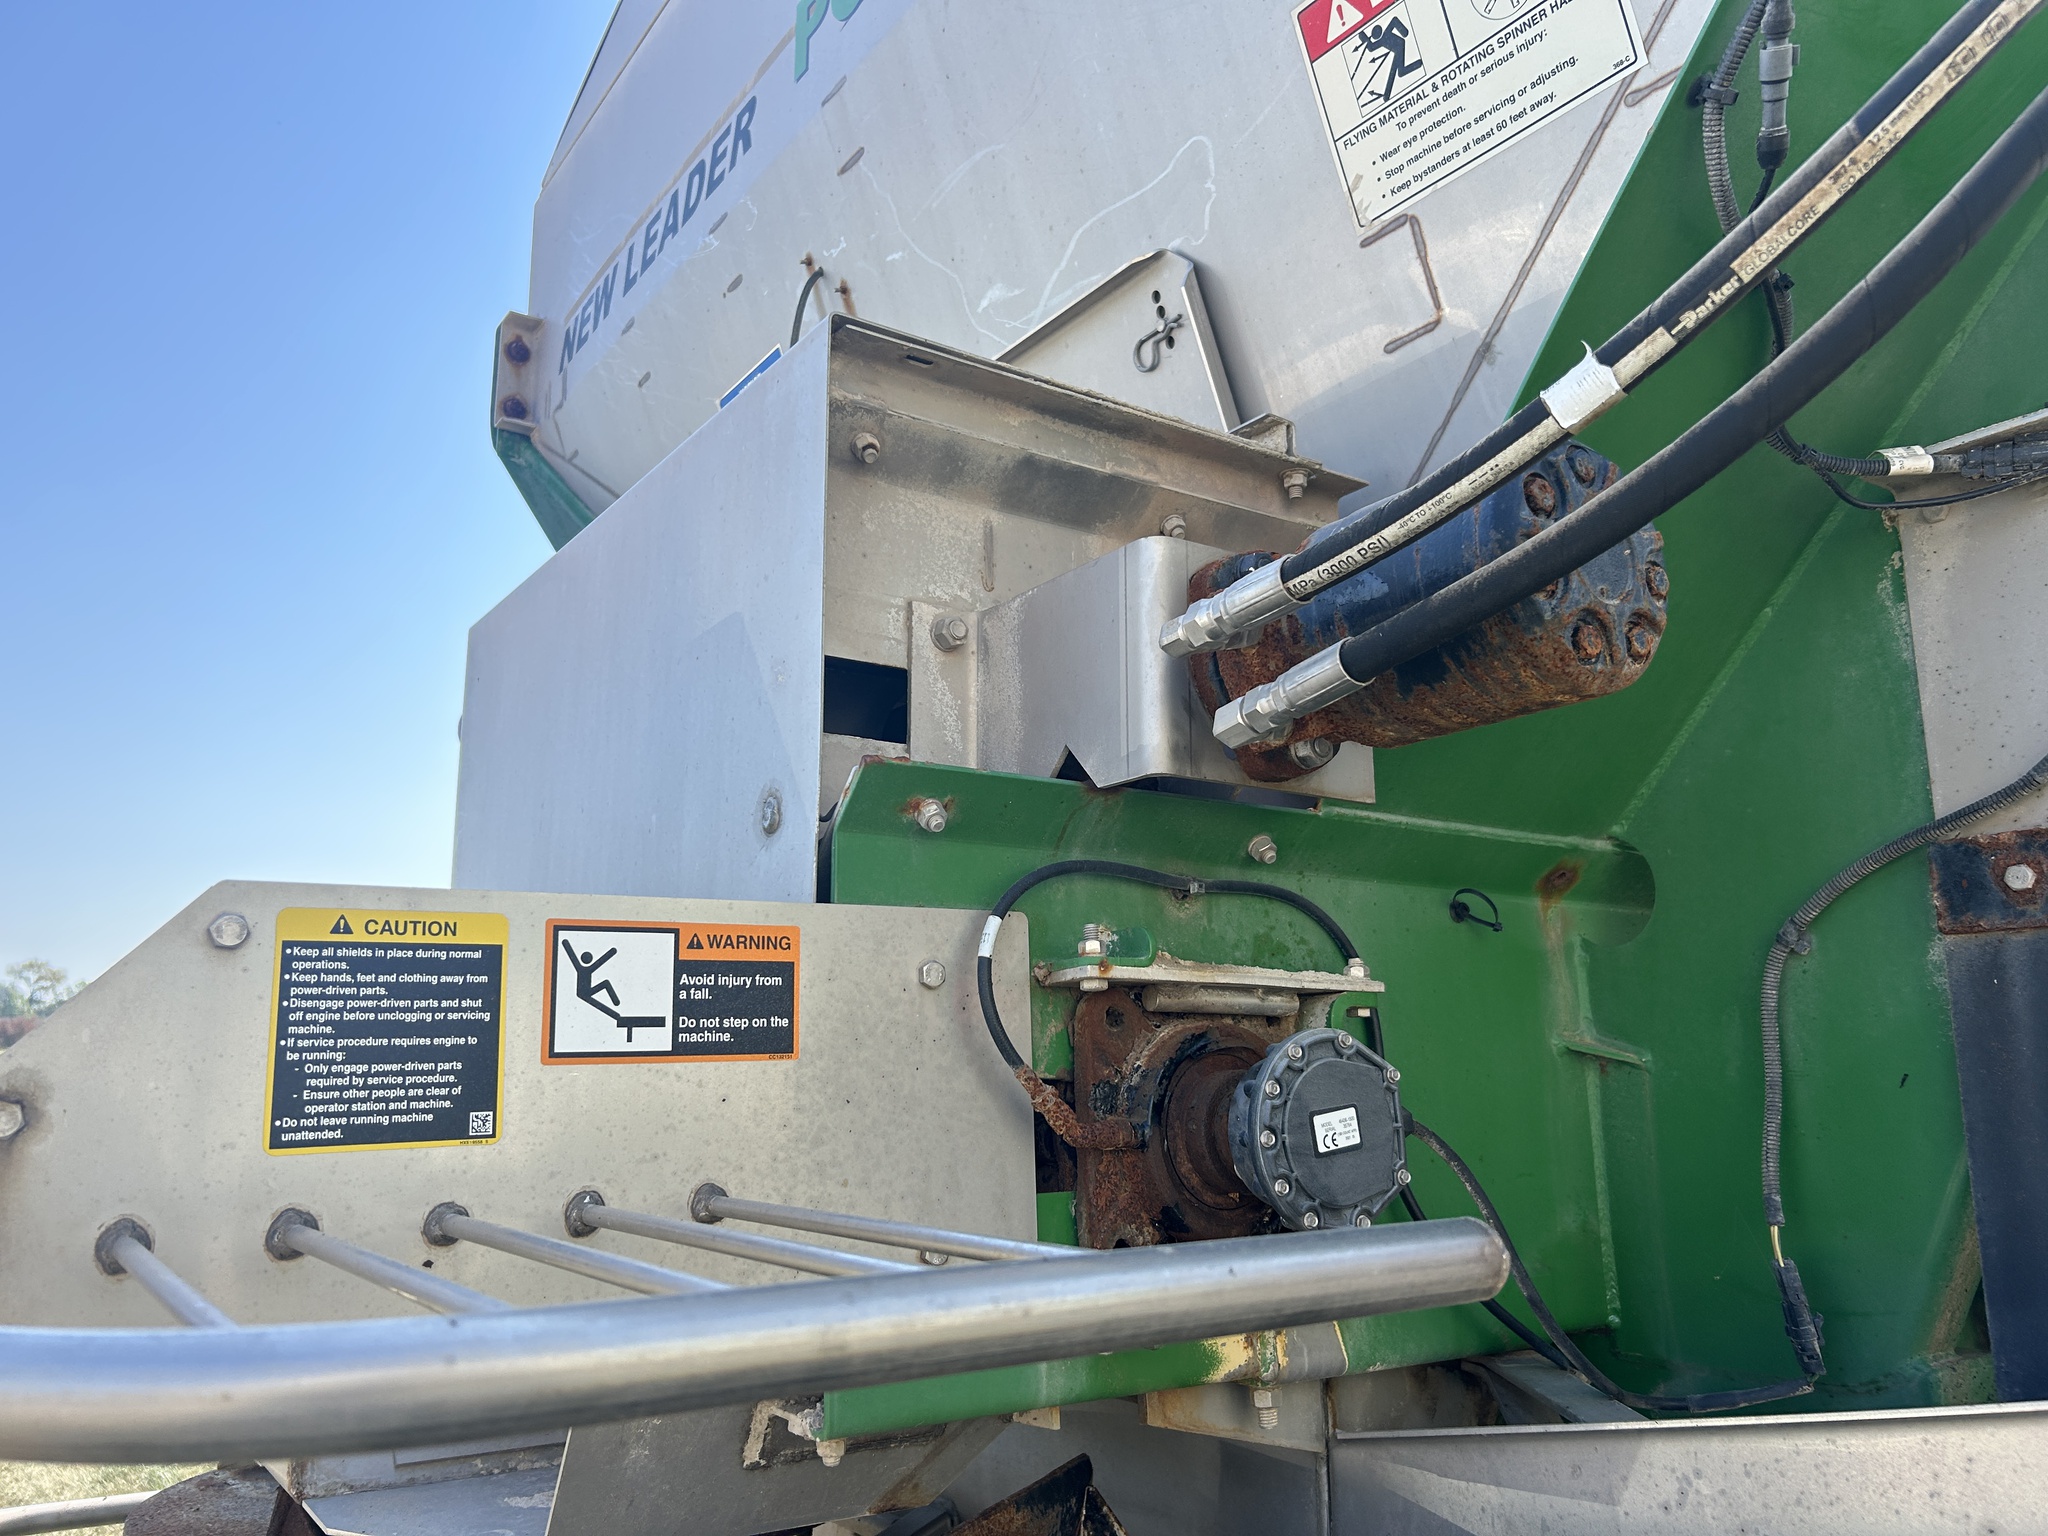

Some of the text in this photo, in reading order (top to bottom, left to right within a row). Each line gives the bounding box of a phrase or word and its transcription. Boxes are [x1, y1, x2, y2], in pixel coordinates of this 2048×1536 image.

[1343, 122, 1378, 151] FLYING
[1378, 89, 1430, 128] MATERIAL
[1431, 82, 1439, 93] &
[1440, 43, 1495, 87] ROTATING
[1496, 8, 1548, 48] SPINNER
[1395, 28, 1548, 132] To prevent death or serious injury:
[1385, 55, 1579, 180] Stop machine before servicing or adjusting.
[1379, 105, 1466, 162] Wear eye protection.
[1390, 90, 1557, 197] Keep bystanders at least 60 feet away.
[558, 95, 757, 375] NEW LEADER
[1675, 275, 1741, 330] Parker
[1416, 509, 1426, 519] TO
[1286, 535, 1391, 598] MPa (3000 PSI)
[364, 919, 457, 936] CAUTION
[706, 934, 791, 951] WARNING
[293, 946, 482, 960] Keep all shields in place during normal
[292, 960, 350, 971] operations.
[291, 972, 488, 985] Keep hands, feet and clothing away from
[680, 974, 782, 988] Avoid injury from
[290, 985, 388, 997] power-driven parts.
[679, 988, 712, 999] a fall.
[289, 998, 482, 1009] Disengage power-driven parts and shut
[289, 1010, 490, 1022] off engine before unclogging or servicing
[679, 1016, 789, 1030] Do not step on the
[288, 1024, 335, 1034] machine.
[679, 1030, 734, 1042] machine.
[287, 1036, 477, 1048] If service procedure requires engine to
[286, 1050, 346, 1061] be running:
[304, 1061, 462, 1075] Only engage power-driven parts
[306, 1074, 457, 1088] required by service procedure.
[303, 1085, 462, 1100] Ensure other people are clear of
[304, 1099, 453, 1115] operator station and machine.
[282, 1112, 434, 1127] Do not leave running machine
[281, 1129, 343, 1141] unattended.
